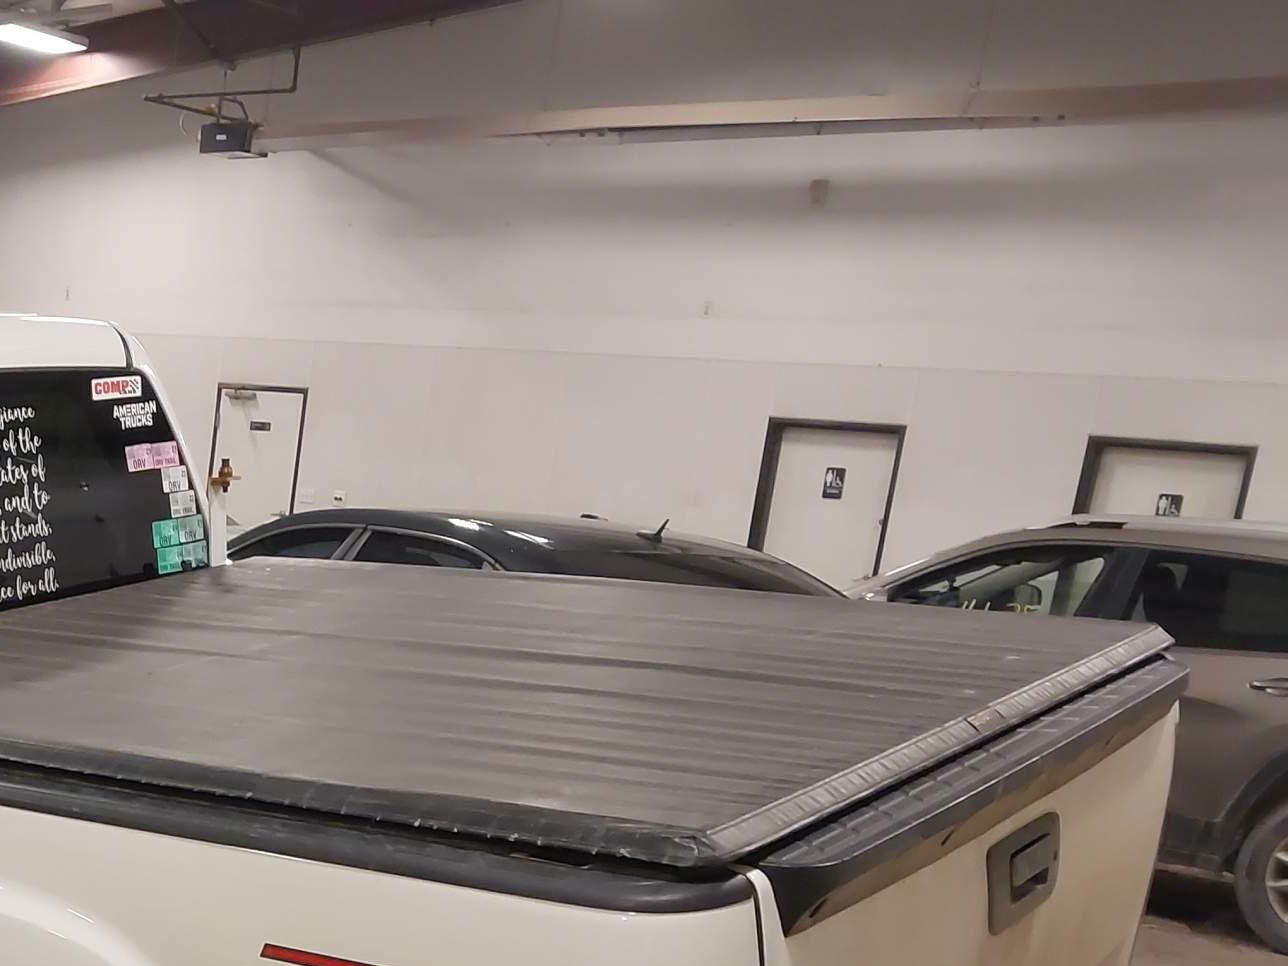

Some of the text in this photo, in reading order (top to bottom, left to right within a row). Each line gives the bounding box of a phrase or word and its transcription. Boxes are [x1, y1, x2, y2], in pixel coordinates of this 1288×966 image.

[113, 400, 157, 419] AMERICAN
[119, 413, 153, 430] TRUCKS
[3, 429, 17, 456] of
[17, 427, 41, 454] the
[31, 453, 46, 482] of
[4, 484, 32, 512] and
[33, 482, 50, 510] to
[16, 574, 37, 601] for
[38, 567, 60, 594] all.
